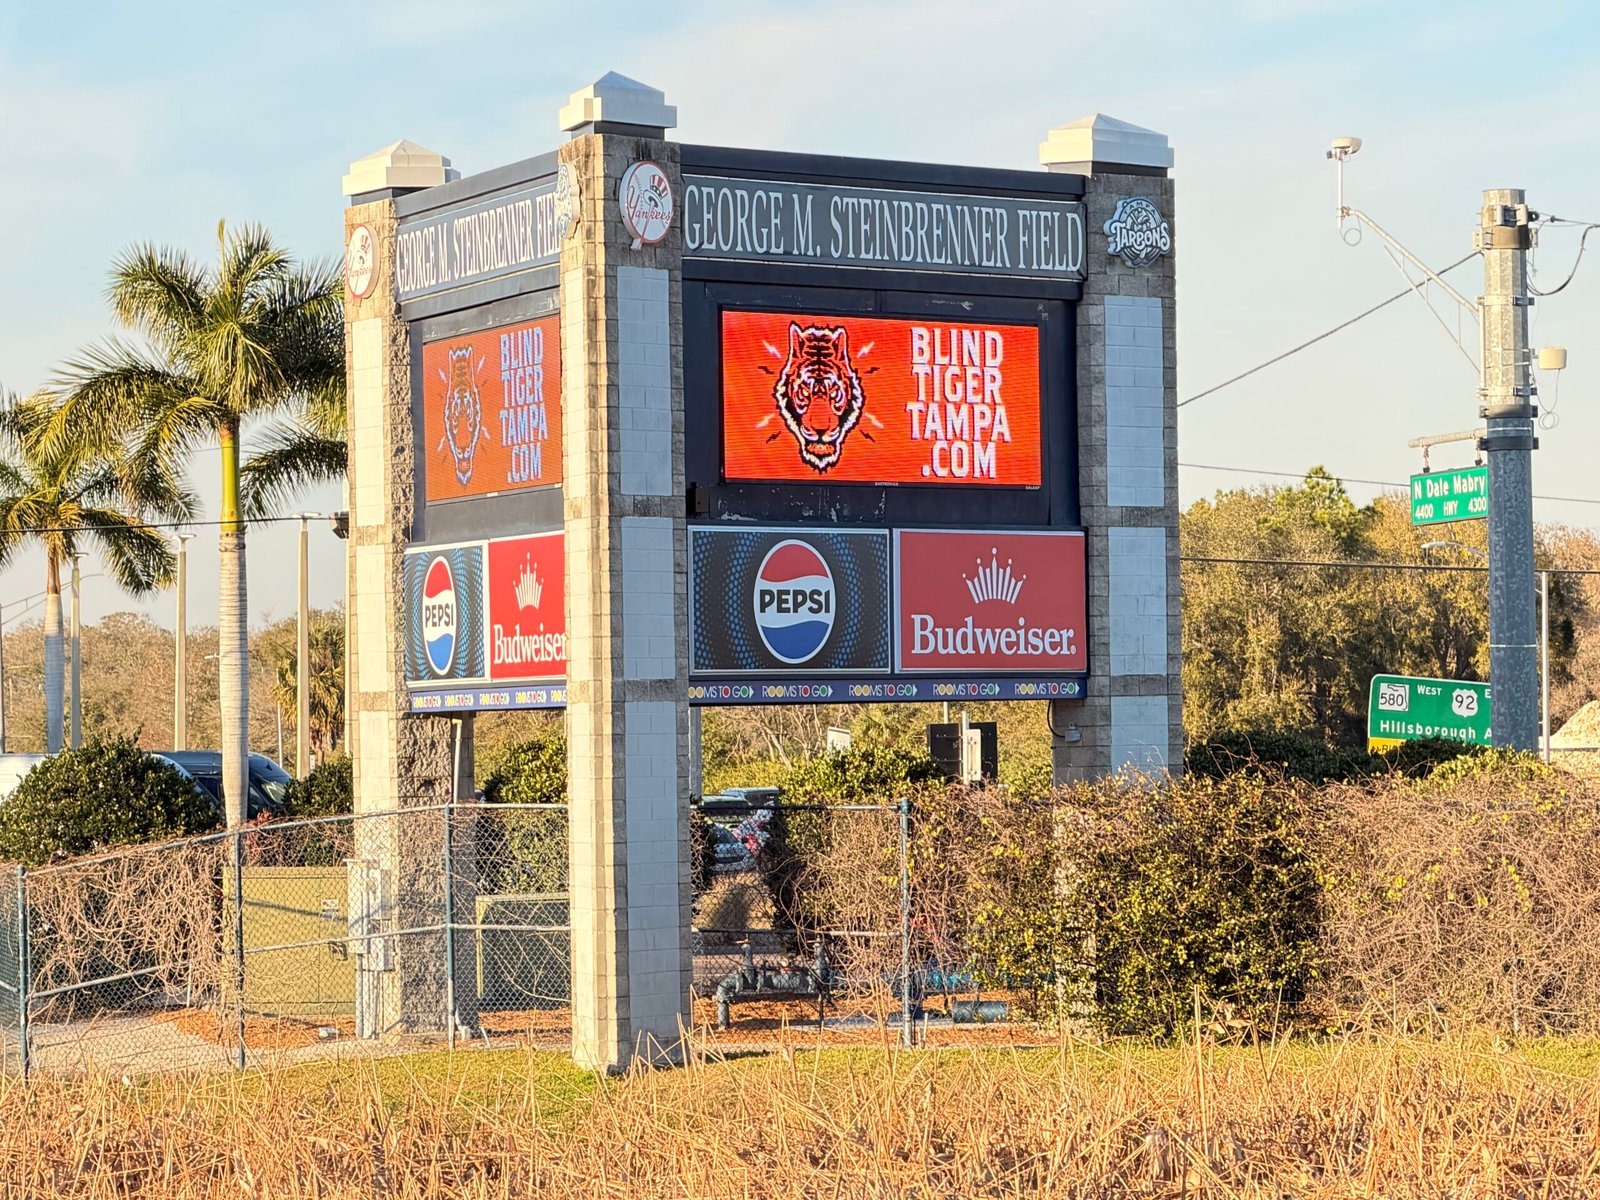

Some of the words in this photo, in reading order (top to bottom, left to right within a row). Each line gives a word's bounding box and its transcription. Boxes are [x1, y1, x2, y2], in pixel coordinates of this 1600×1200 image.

[627, 185, 673, 223] Yankees
[1123, 201, 1157, 216] TAMPA
[684, 184, 783, 255] GEORGE
[793, 191, 821, 258] M.
[830, 195, 1012, 270] STEINBRENNER
[1017, 208, 1084, 273] FIELD
[1110, 221, 1171, 252] TARPONS
[396, 225, 437, 294] GEORGE
[437, 222, 451, 284] M.
[453, 199, 535, 281] STEINBRENNER
[536, 191, 561, 258] FIEL
[500, 326, 544, 371] BLIND
[911, 326, 1004, 368] BLIND
[501, 364, 544, 408] TIGER
[911, 364, 1002, 405] TIGER
[499, 403, 549, 447] TAMPA
[905, 402, 1012, 443] TAMPA
[507, 441, 542, 484] .COM
[921, 441, 997, 480] .COM
[1414, 480, 1422, 500] N
[1426, 477, 1449, 498] Dale
[1453, 474, 1486, 496] Mabry
[1415, 503, 1434, 520] 4400
[1443, 500, 1458, 517] HWY
[1468, 496, 1487, 513] 4300
[759, 588, 831, 614] PEPSI
[425, 602, 455, 628] PEPSI
[493, 622, 567, 664] Budweiser
[688, 686, 717, 699] OOMS
[718, 686, 731, 698] TO
[732, 686, 748, 698] GO
[762, 686, 797, 698] ROOMS
[798, 685, 810, 698] TO
[811, 685, 828, 698] GO
[849, 685, 882, 697] ROOMS
[883, 685, 896, 697] TO
[896, 684, 913, 697] GO
[933, 684, 966, 696] ROOMS
[967, 683, 978, 696] TO
[979, 683, 995, 696] GO
[1015, 683, 1047, 696] ROOMS
[1047, 683, 1059, 695] TO
[1060, 683, 1075, 695] GO
[1380, 692, 1404, 706] 580
[1417, 684, 1443, 696] WEST
[1455, 694, 1475, 710] 92
[1484, 688, 1492, 699] E
[1380, 720, 1476, 740] Hillsborough
[1484, 728, 1493, 740] A
